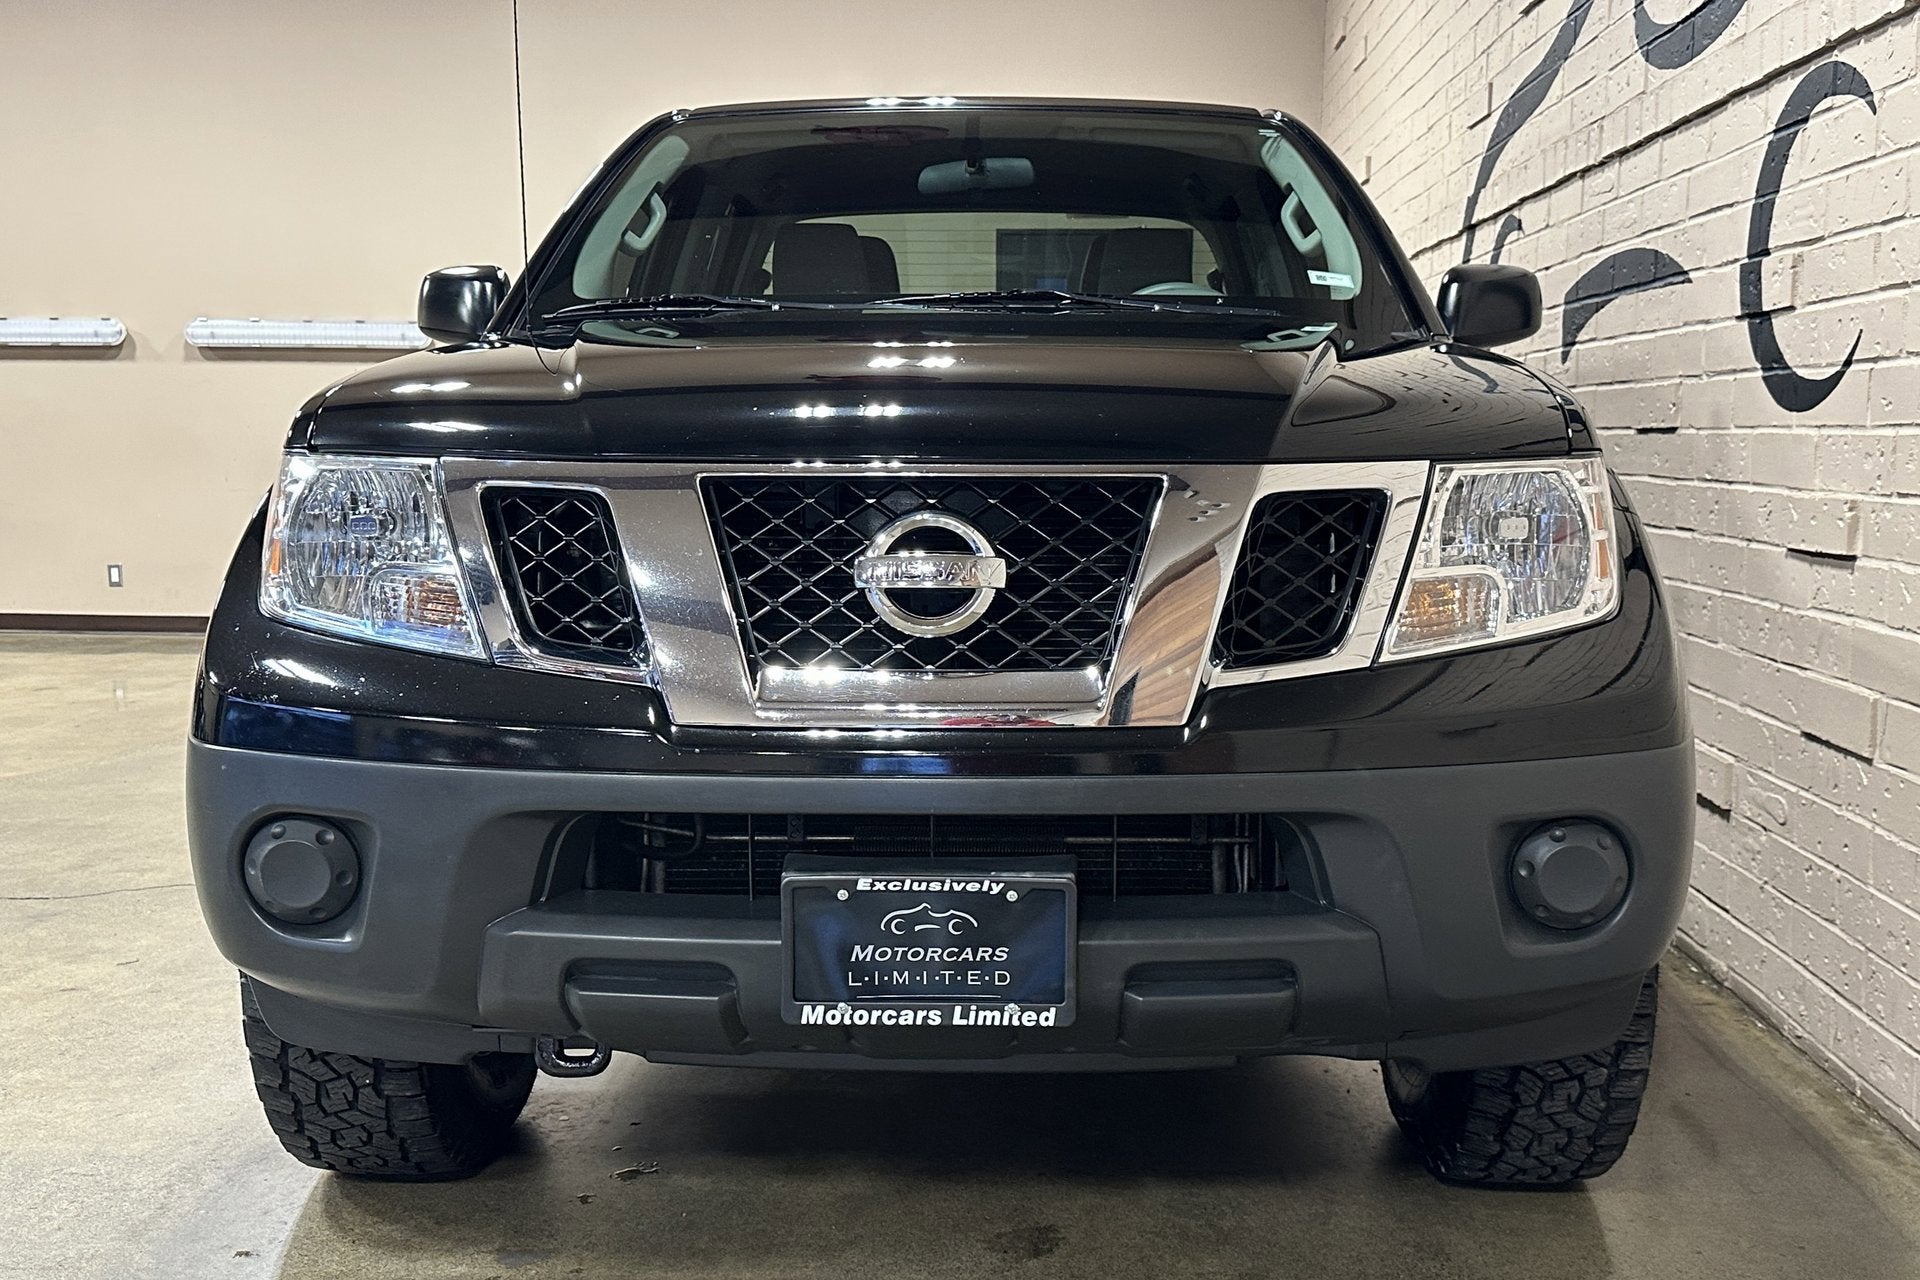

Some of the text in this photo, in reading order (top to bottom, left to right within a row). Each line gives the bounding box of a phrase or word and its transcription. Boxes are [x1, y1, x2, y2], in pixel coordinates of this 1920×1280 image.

[857, 878, 1004, 894] Exclusively
[850, 945, 1009, 962] MOTORCARS
[801, 1005, 1056, 1027] Motorcars Limited
